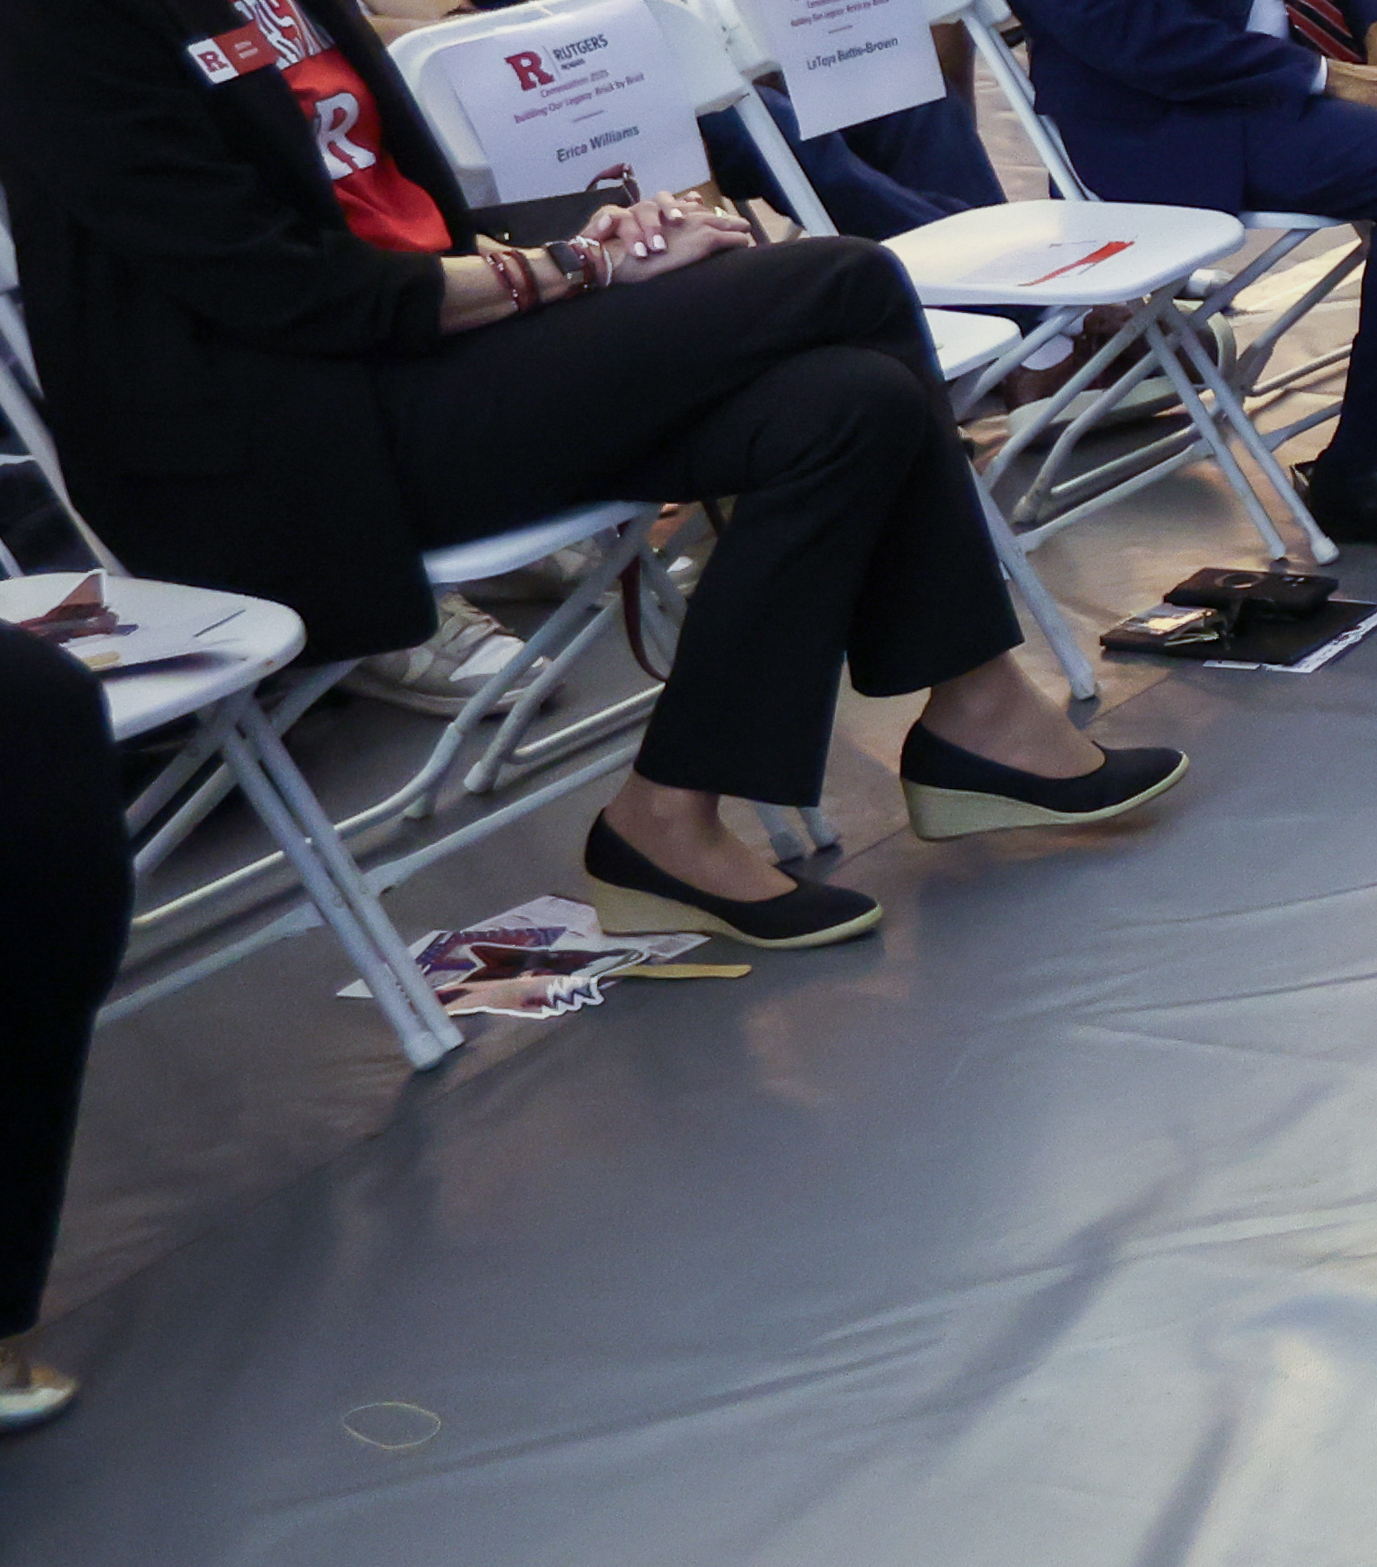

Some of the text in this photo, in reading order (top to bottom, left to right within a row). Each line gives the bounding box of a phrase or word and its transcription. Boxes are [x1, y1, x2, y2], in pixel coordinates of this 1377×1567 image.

[552, 33, 609, 61] RUTGERS
[504, 51, 555, 91] R
[315, 92, 376, 180] R
[556, 125, 640, 163] Erica Williams
